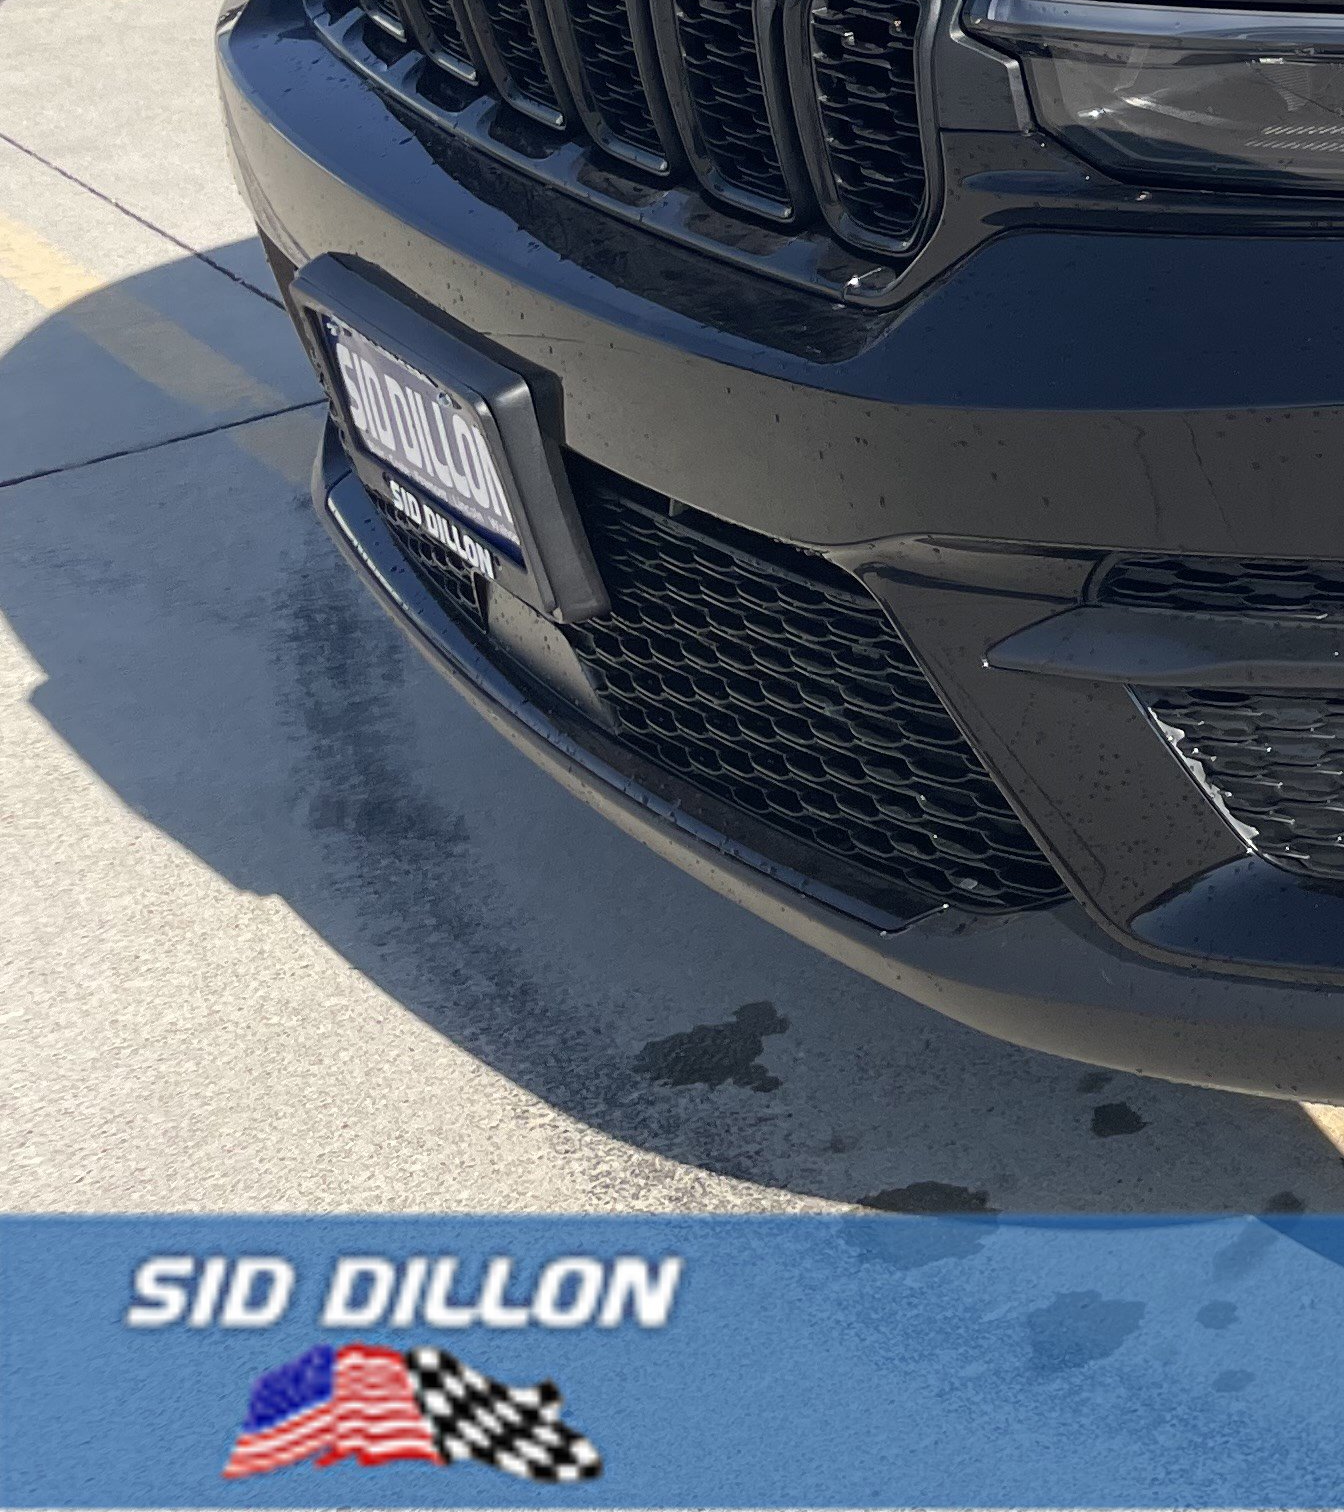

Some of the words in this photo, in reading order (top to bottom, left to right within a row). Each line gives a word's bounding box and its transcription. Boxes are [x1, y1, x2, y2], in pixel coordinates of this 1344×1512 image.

[335, 343, 395, 451] SID
[384, 373, 514, 525] DILLON
[389, 479, 422, 525] SID
[422, 503, 496, 580] DILLON
